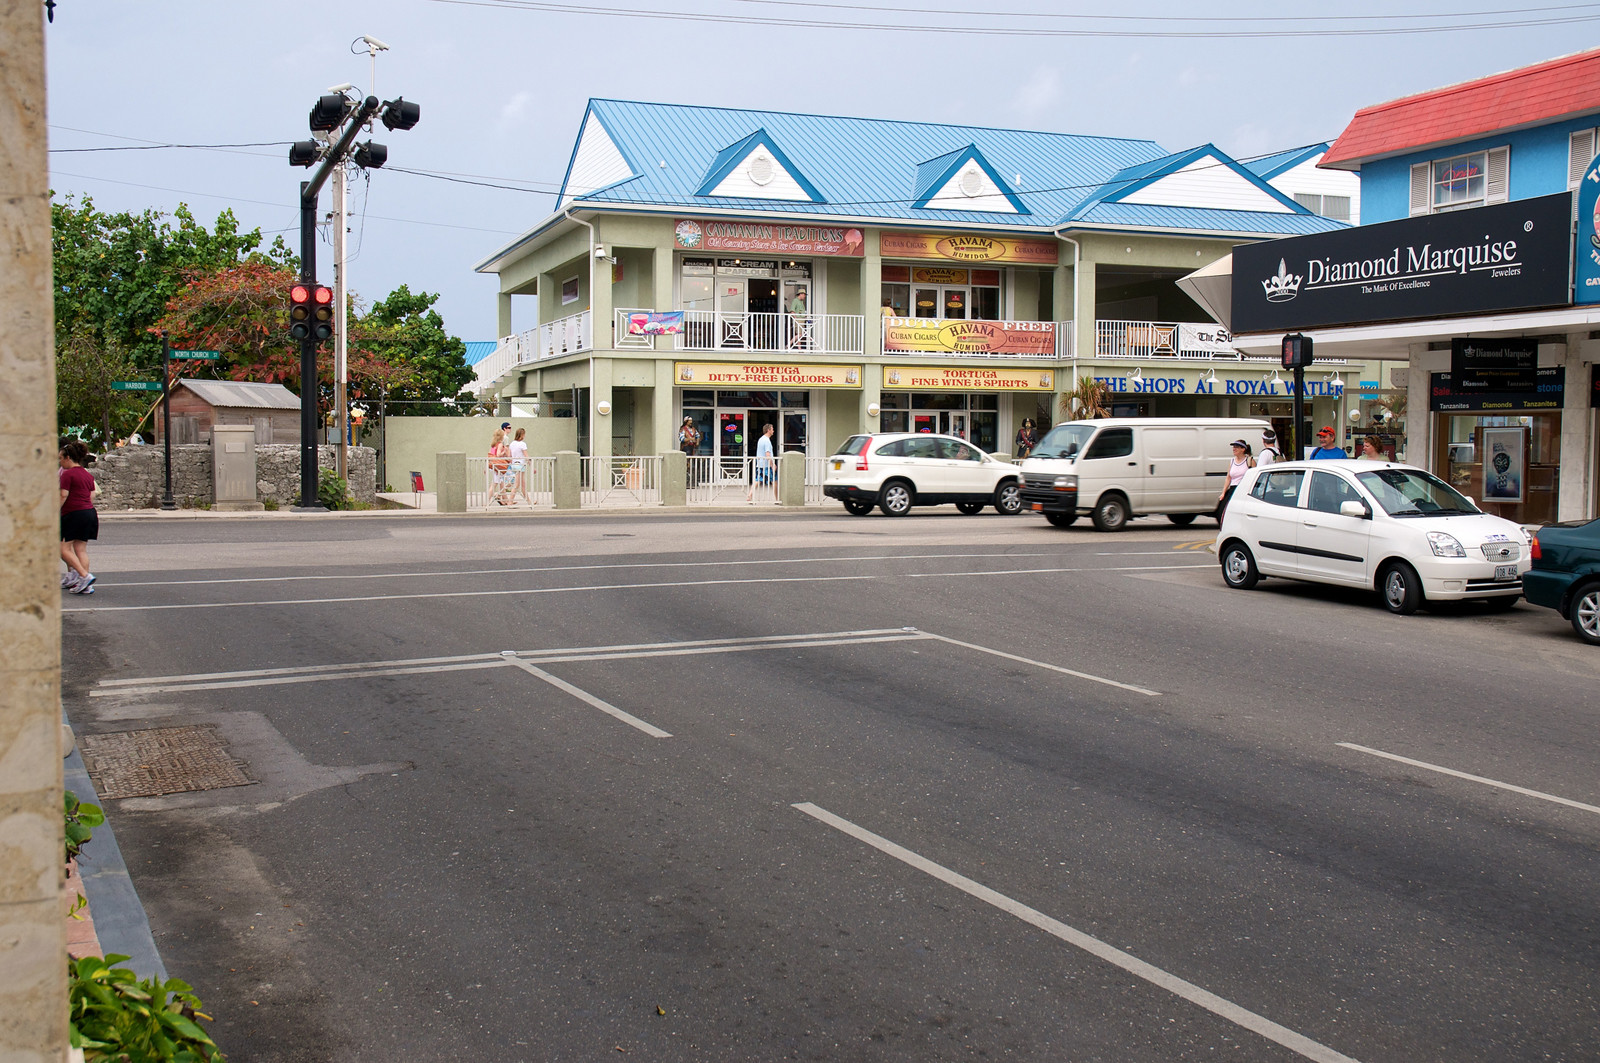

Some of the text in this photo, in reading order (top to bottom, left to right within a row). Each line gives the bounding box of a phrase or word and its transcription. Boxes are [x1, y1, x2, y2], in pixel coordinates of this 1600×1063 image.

[706, 223, 844, 243] CAYMANIAN TRADITIONS
[750, 239, 769, 249] Store
[769, 241, 777, 250] &
[778, 241, 788, 251] Ice
[789, 243, 812, 251] Cream
[949, 237, 994, 249] HAVANA
[952, 251, 990, 260] HUMIDOR
[1307, 234, 1518, 285] Diamond Marquise
[721, 259, 774, 269] ICE CREAM
[925, 268, 956, 276] HAVANA
[1491, 267, 1522, 279] Jewelers
[1361, 280, 1431, 294] The Mark Of Excellence
[889, 317, 1053, 331] DUTY FREE
[949, 323, 995, 337] HAVANA
[890, 331, 937, 341] CUBAN CIGARS
[1008, 335, 1029, 343] CUBAN
[1197, 332, 1214, 342] The
[953, 342, 991, 351] HUMIDOR
[1476, 349, 1531, 361] Diamond Marquise
[742, 365, 800, 375] TORTUGA
[943, 370, 998, 378] TORTUGA
[708, 373, 834, 384] DUTY-FREE LIQUORS
[911, 378, 939, 386] FINE
[942, 378, 972, 387] WINE
[983, 380, 1029, 388] SPIRITS
[1134, 378, 1185, 394] SHOPS
[1225, 380, 1279, 395] ROYAL
[1433, 387, 1450, 396] Sale
[1537, 383, 1563, 392] stone
